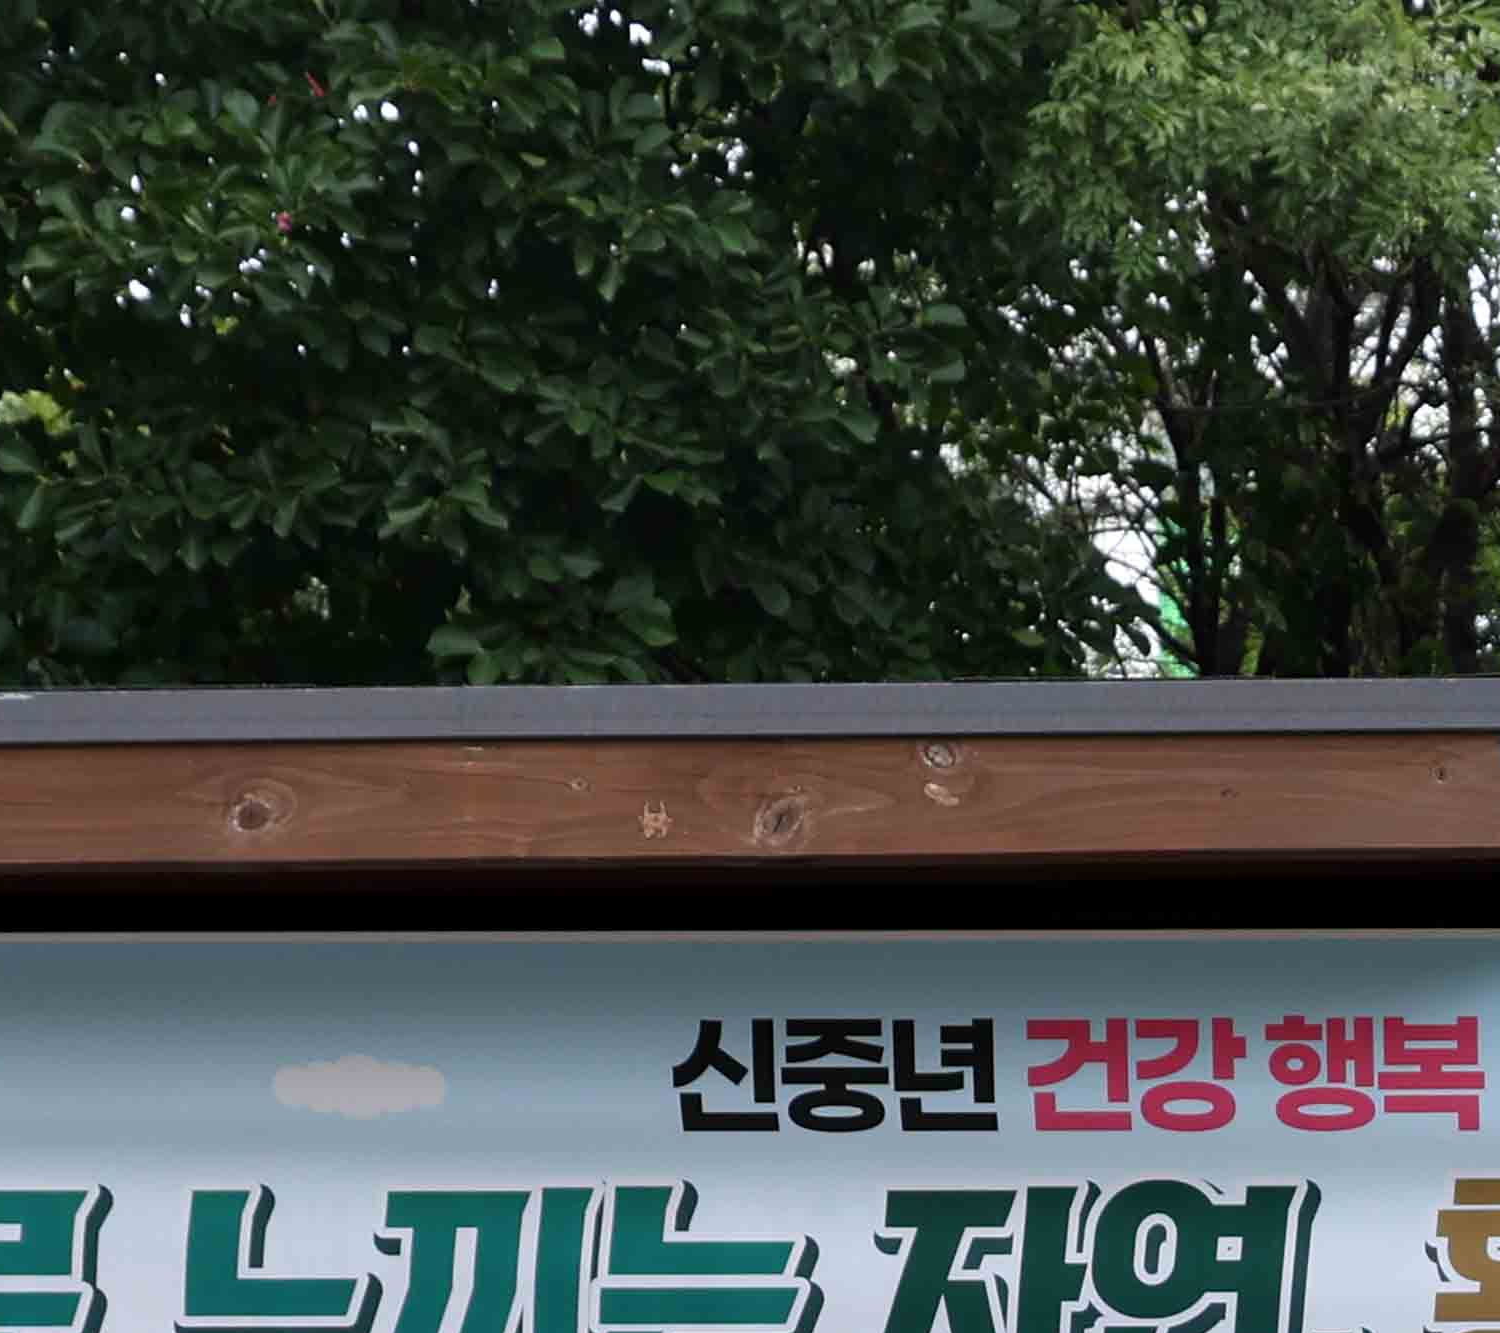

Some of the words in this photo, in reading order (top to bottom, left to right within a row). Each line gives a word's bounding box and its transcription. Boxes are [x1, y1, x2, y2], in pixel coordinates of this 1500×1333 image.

[672, 1017, 998, 1132] 신중년
[1028, 1017, 1244, 1130] 건강
[1267, 1016, 1482, 1130] 행복
